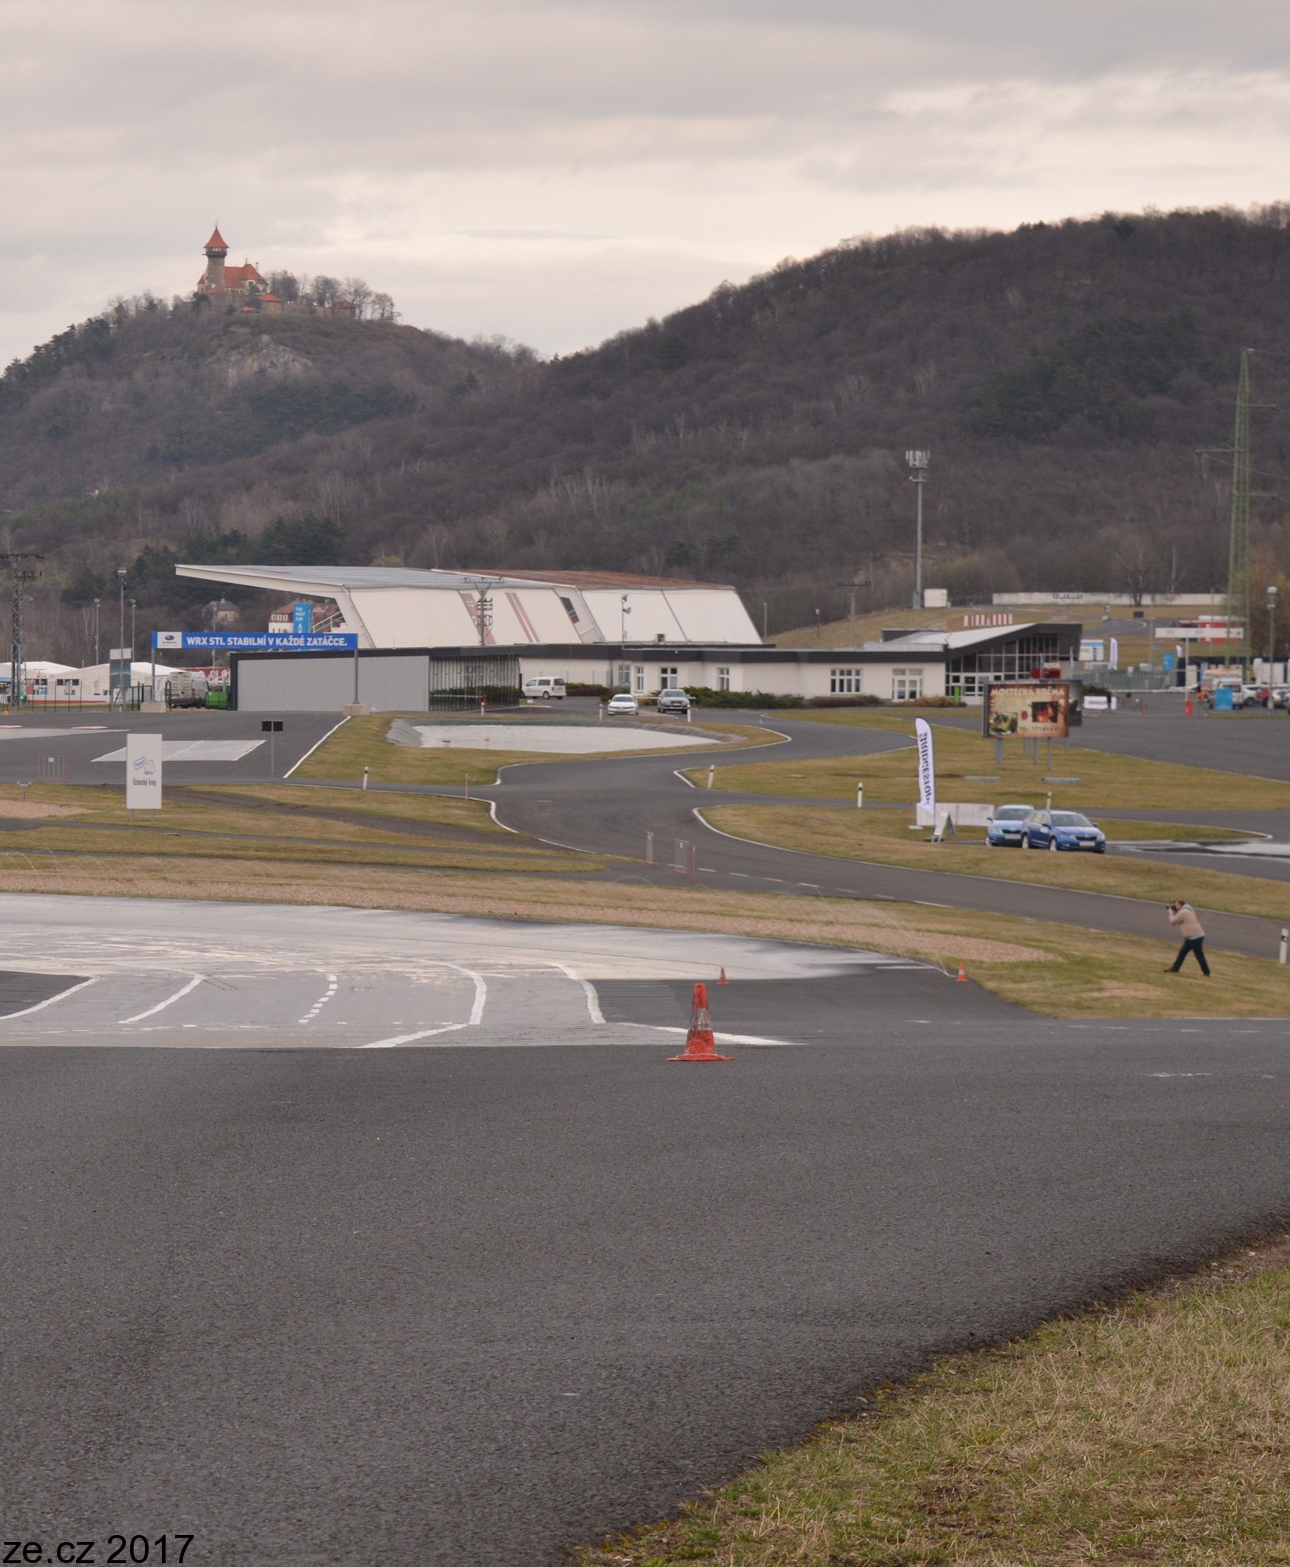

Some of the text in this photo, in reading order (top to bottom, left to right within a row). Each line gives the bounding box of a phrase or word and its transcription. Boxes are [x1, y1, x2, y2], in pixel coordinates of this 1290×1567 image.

[186, 636, 208, 645] WRX
[209, 636, 225, 645] STI.
[227, 634, 266, 645] STABILNÍ
[268, 637, 274, 645] V
[276, 635, 305, 645] KAŽDÉ
[307, 635, 348, 645] ZATÁČCE.
